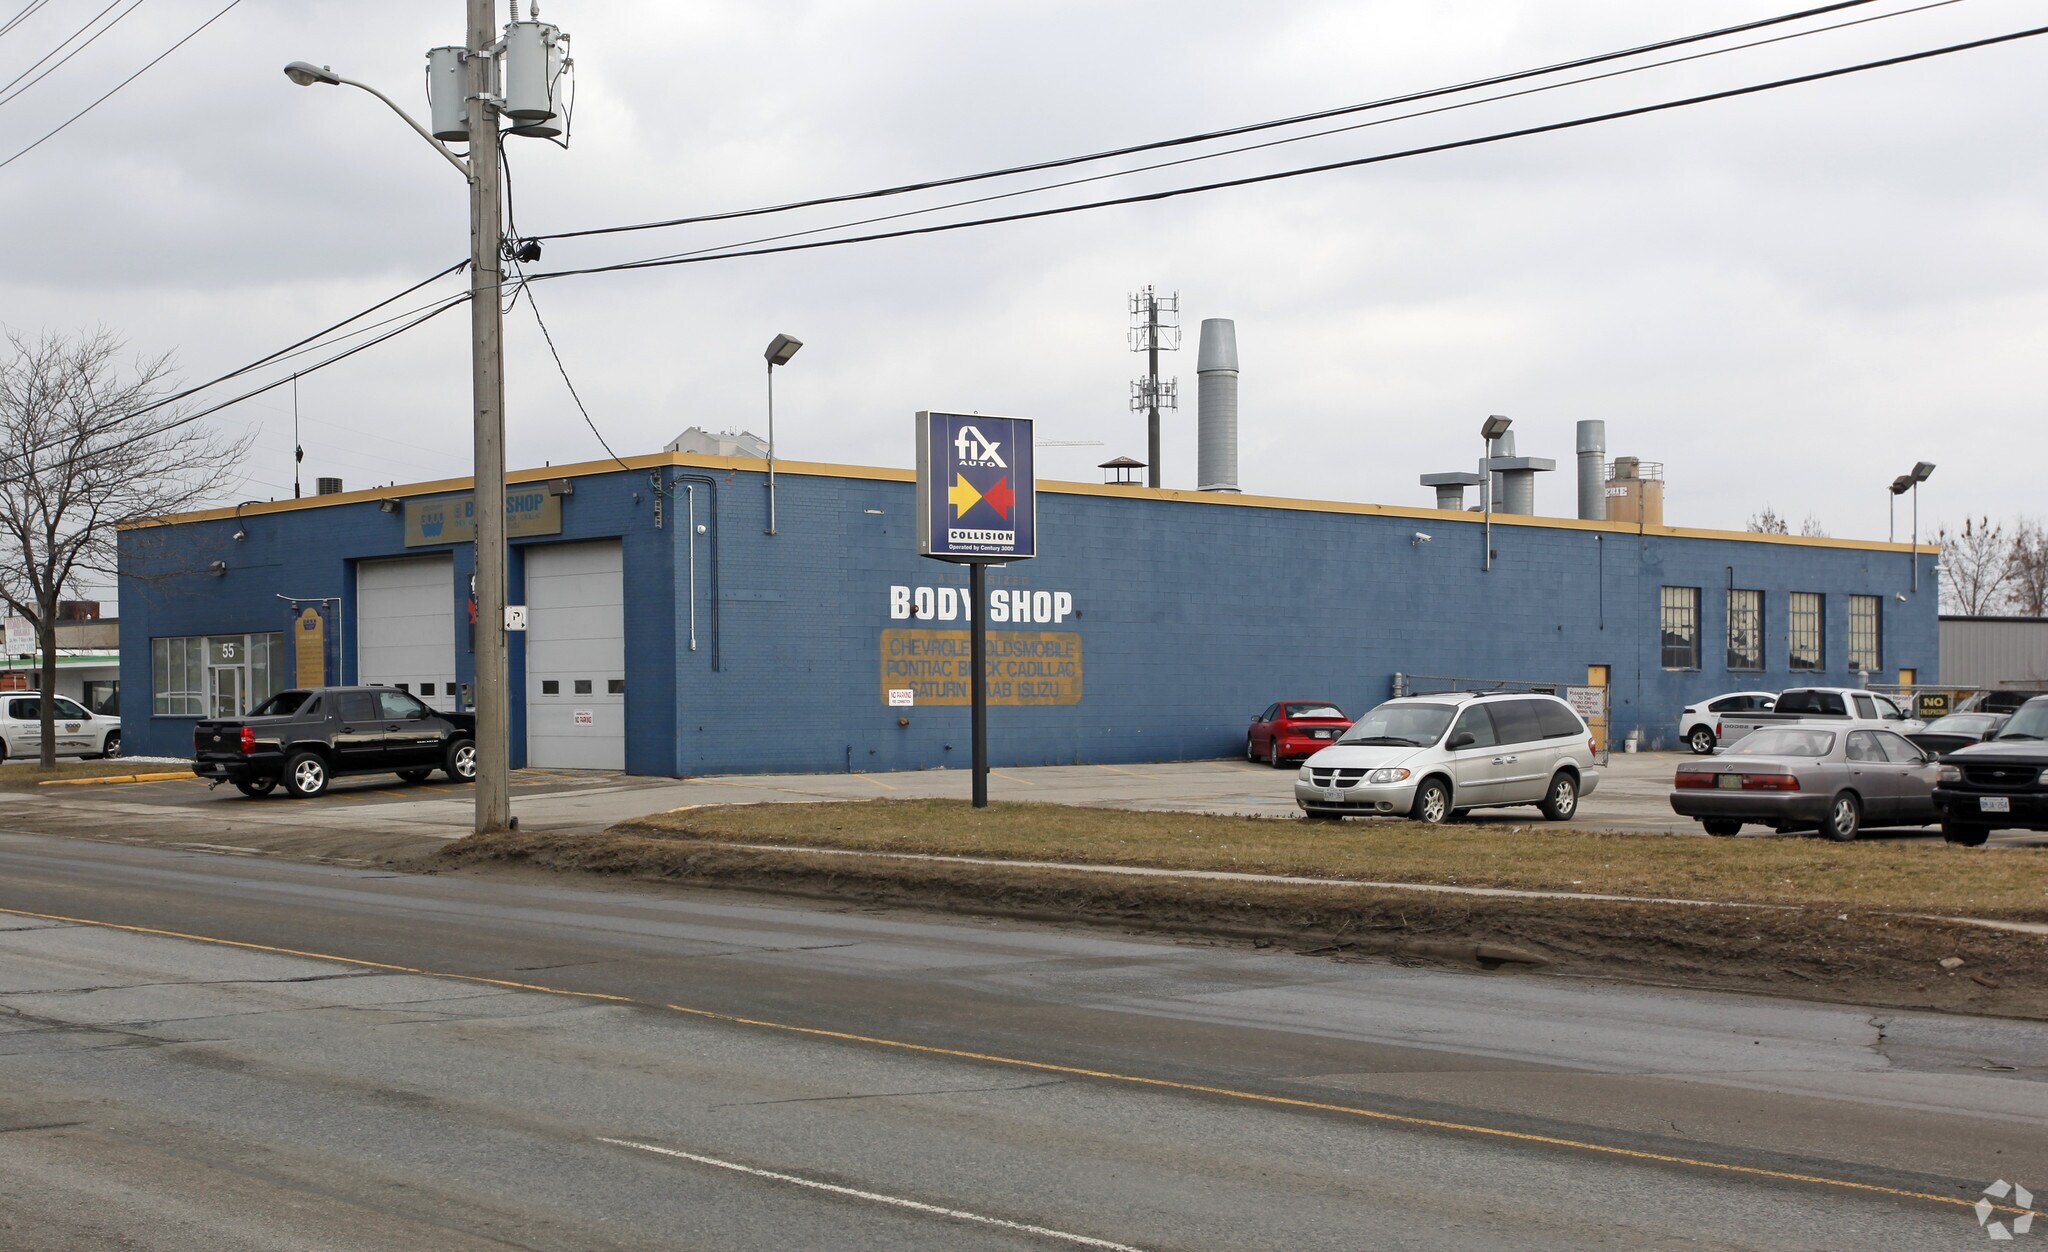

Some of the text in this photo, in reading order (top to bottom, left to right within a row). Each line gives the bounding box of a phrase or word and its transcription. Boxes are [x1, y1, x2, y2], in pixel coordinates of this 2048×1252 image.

[955, 426, 1007, 468] fix
[507, 493, 544, 513] SHOP
[951, 531, 1013, 540] COLLISION
[990, 589, 1072, 624] SHOP
[222, 643, 235, 658] 55
[889, 638, 971, 656] CHEVROLE
[887, 660, 952, 677] PONTIAC
[1007, 661, 1076, 678] CADILLAC
[908, 681, 1060, 698] SATURN AAB ISUZU
[1923, 697, 1944, 706] NO
